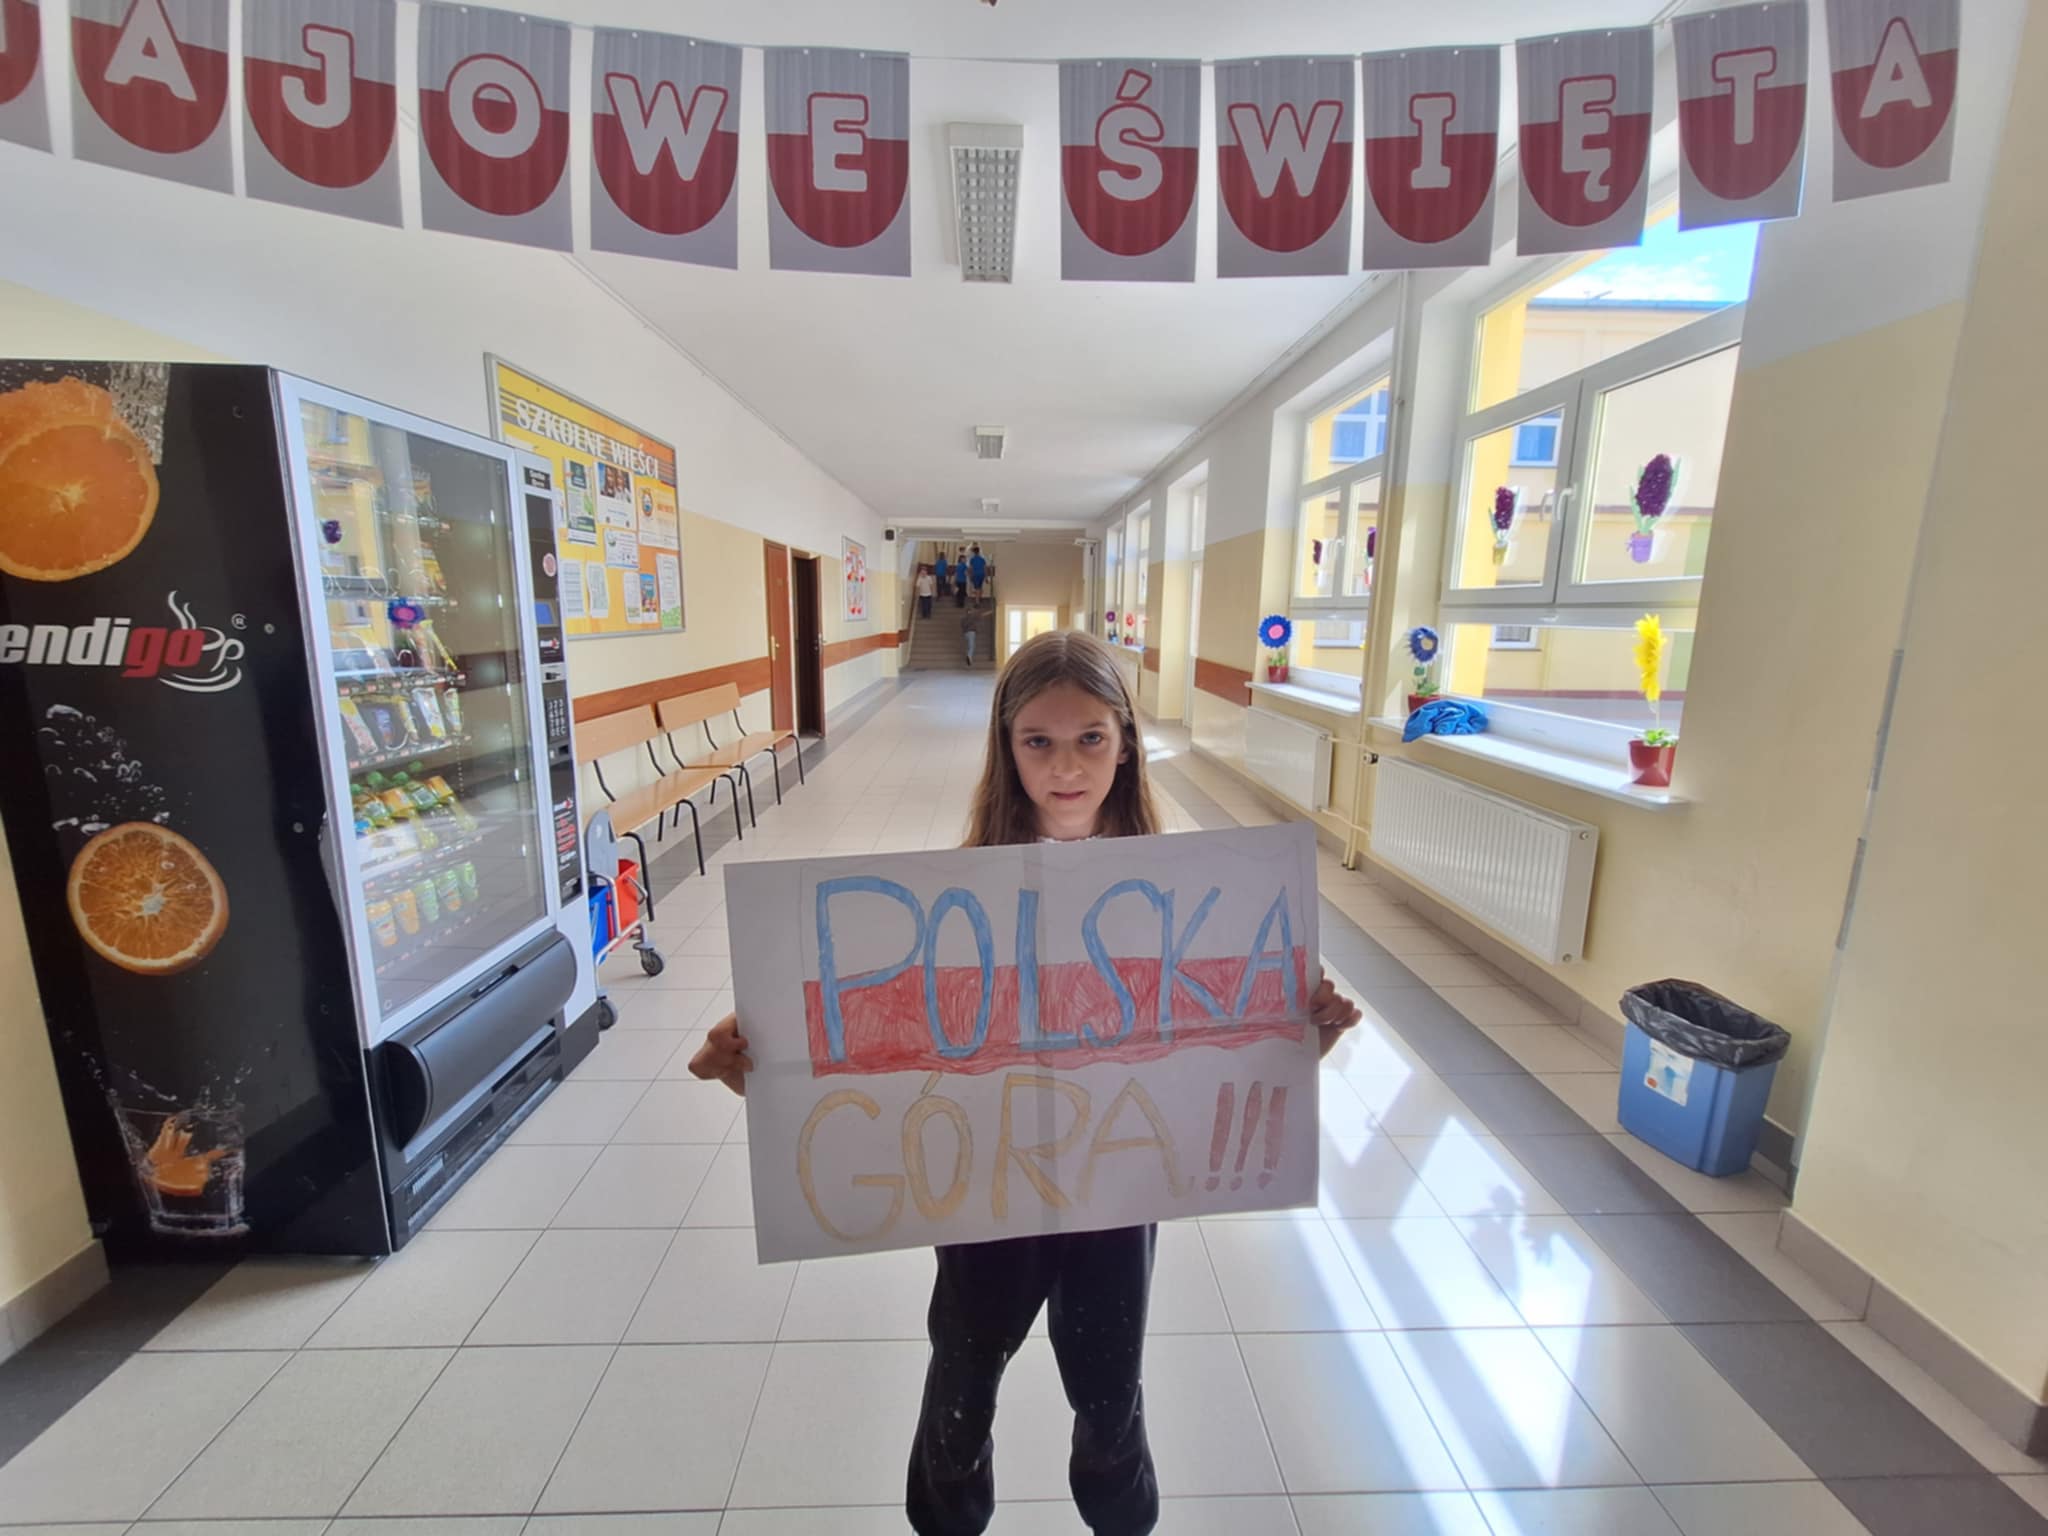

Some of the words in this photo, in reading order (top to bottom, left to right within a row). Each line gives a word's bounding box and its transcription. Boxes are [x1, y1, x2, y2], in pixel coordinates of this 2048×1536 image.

[0, 0, 869, 193] AJOWE
[1095, 16, 1933, 203] ŚWIĘTA
[515, 398, 608, 461] SZKOLNE
[611, 438, 660, 480] WIEŚCI
[815, 875, 1297, 1063] POLSKA
